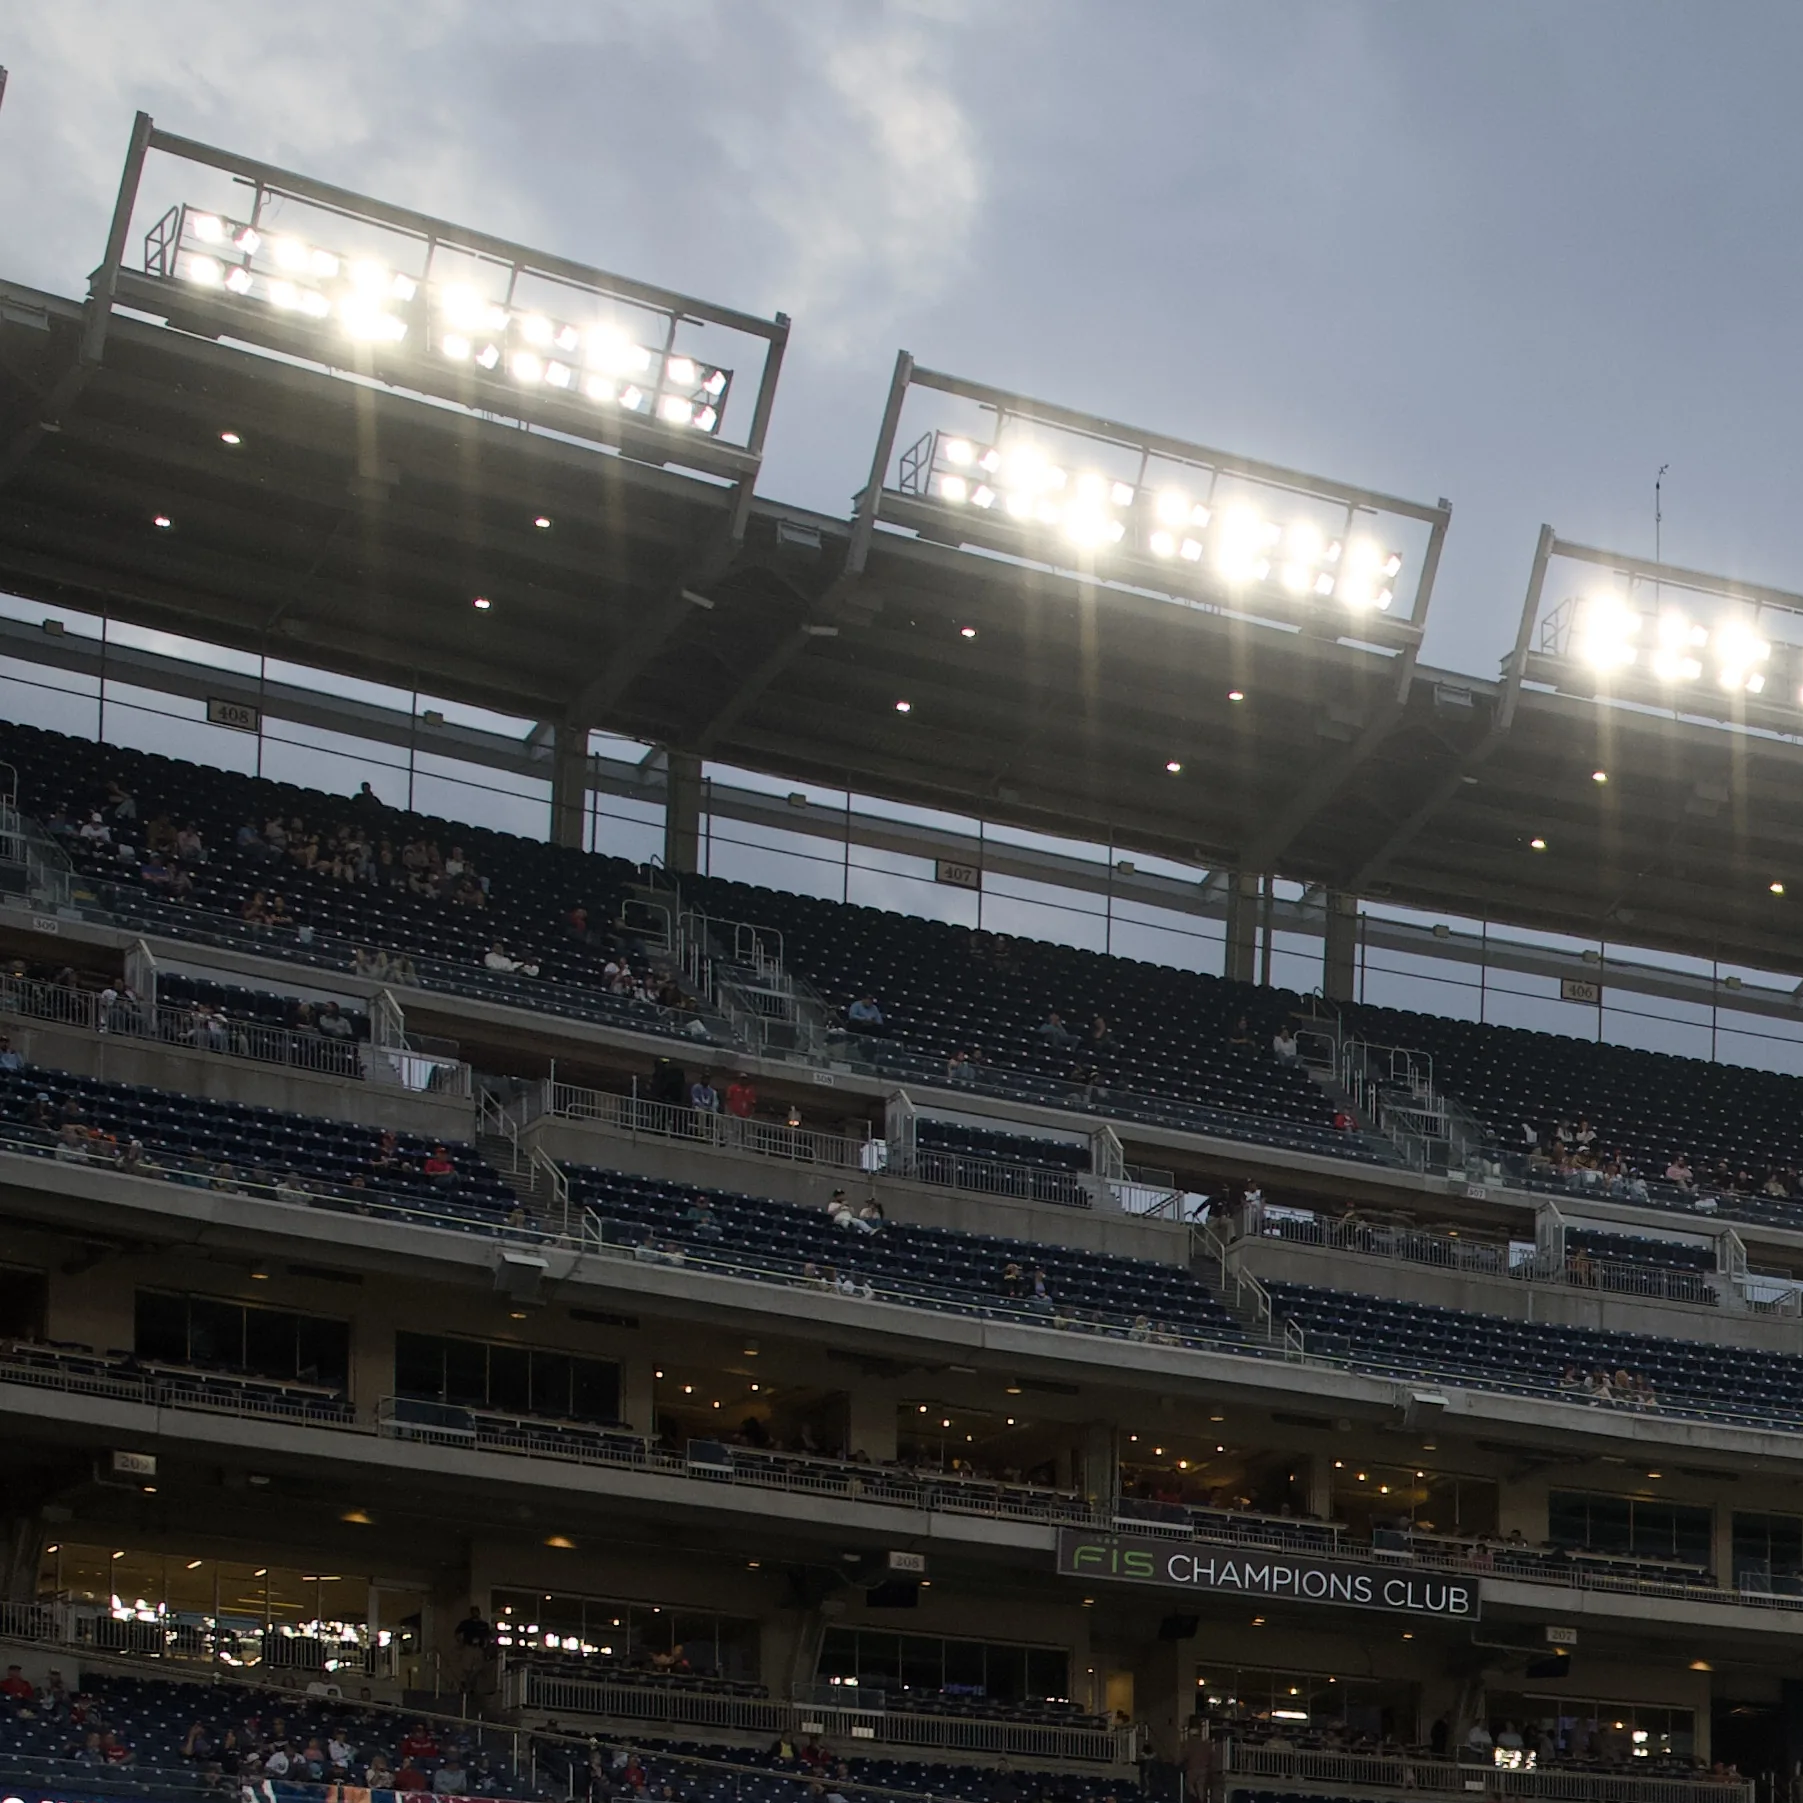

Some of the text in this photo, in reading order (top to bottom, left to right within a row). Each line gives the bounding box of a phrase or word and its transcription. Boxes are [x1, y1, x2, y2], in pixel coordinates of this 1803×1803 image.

[218, 707, 250, 725] 408
[944, 866, 973, 882] 407
[1569, 984, 1593, 999] 406
[1167, 1553, 1373, 1604] CHAMPIONS
[1383, 1579, 1469, 1614] CLUB
